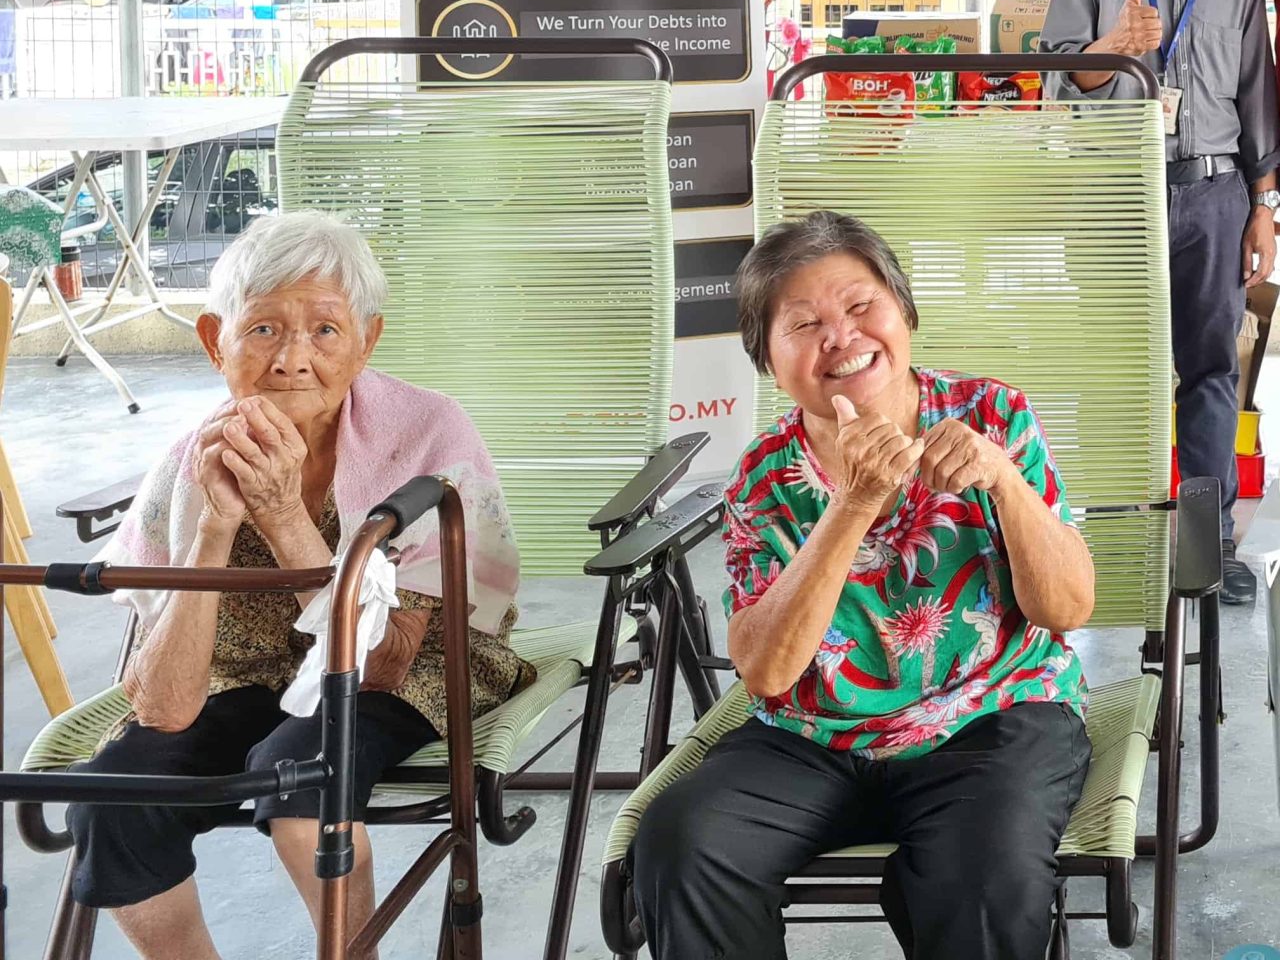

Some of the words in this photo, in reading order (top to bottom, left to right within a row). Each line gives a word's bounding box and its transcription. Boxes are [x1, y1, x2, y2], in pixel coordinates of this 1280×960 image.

[536, 16, 565, 31] We
[568, 15, 604, 30] Turn
[609, 15, 645, 30] Your
[648, 14, 692, 29] Debts
[697, 14, 727, 28] into
[675, 37, 732, 51] Income
[853, 78, 888, 91] BOH
[666, 134, 692, 147] oan
[669, 157, 697, 170] oan
[668, 179, 694, 192] oan
